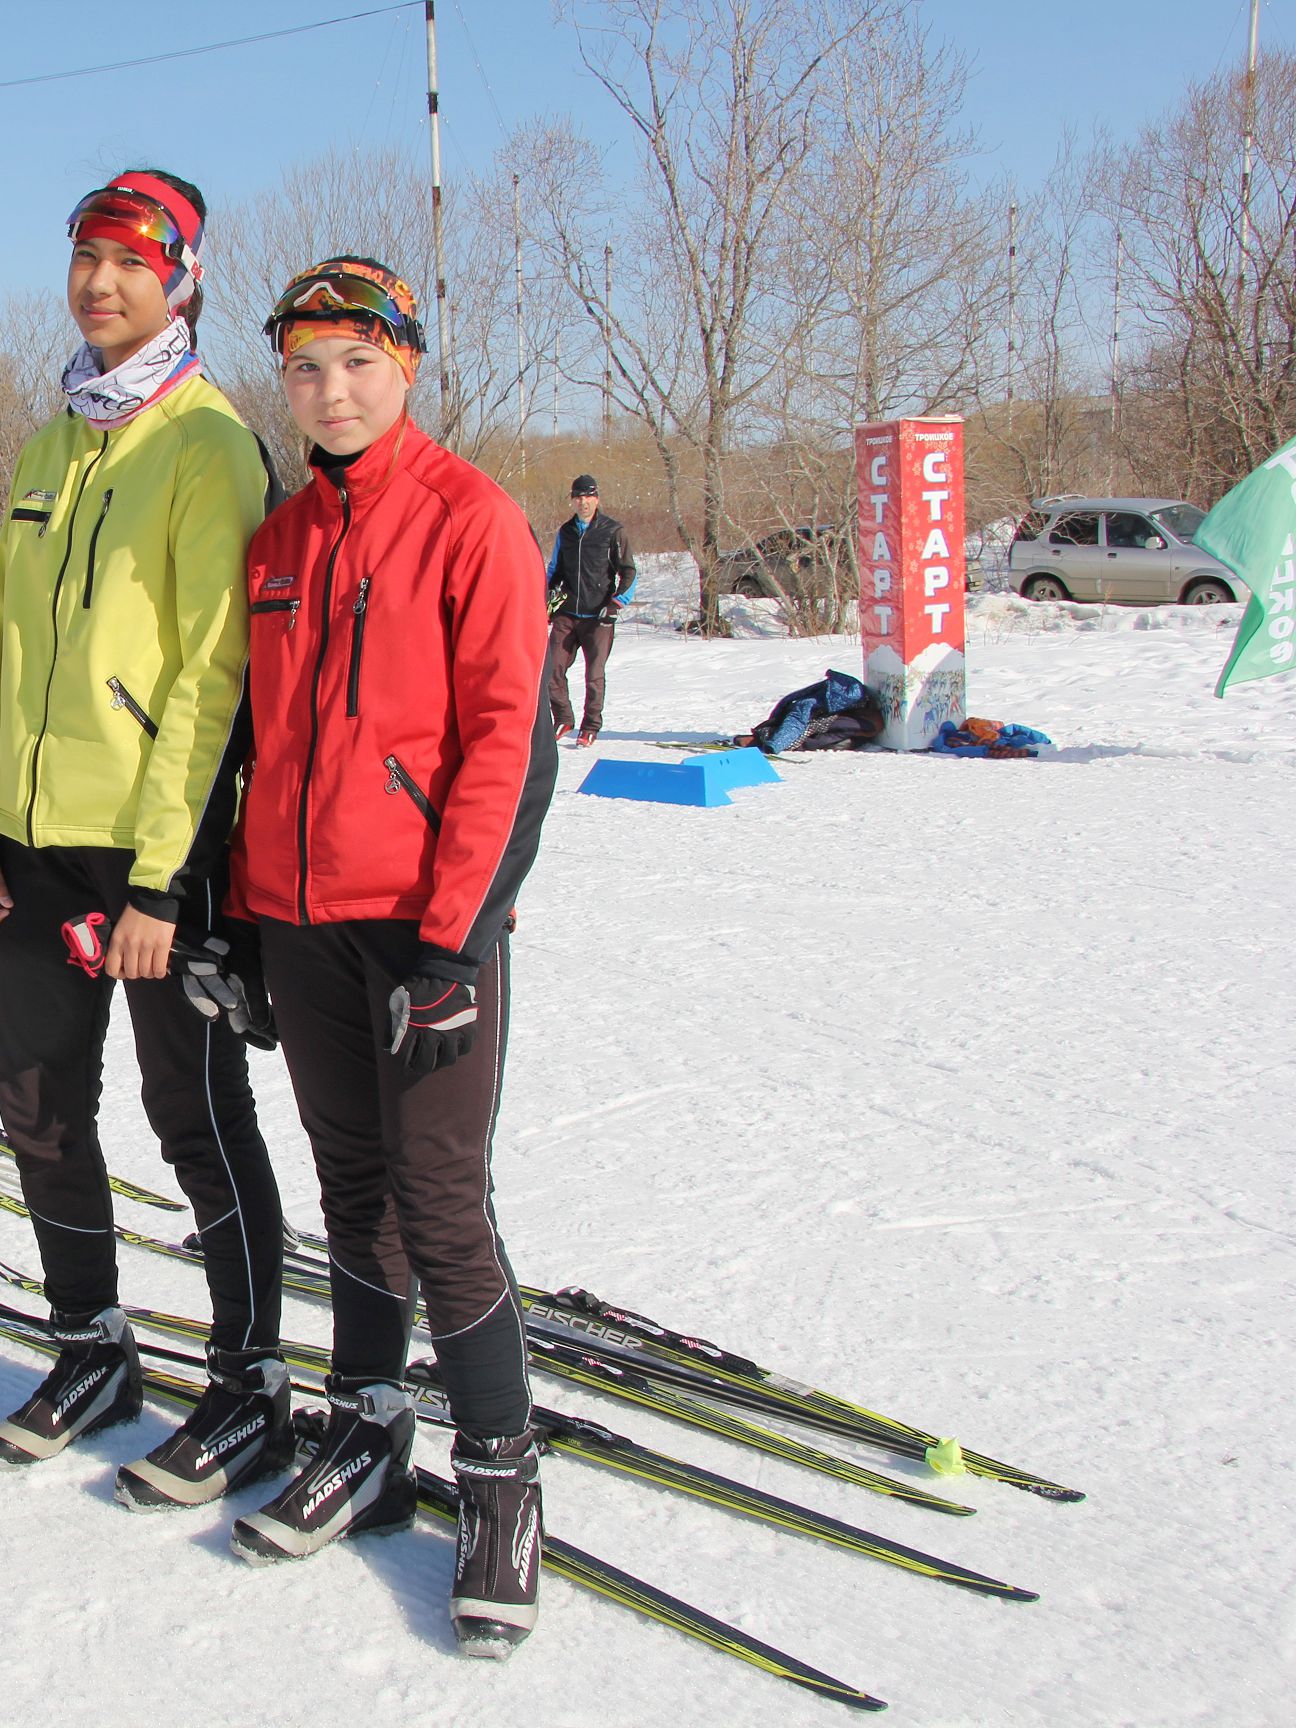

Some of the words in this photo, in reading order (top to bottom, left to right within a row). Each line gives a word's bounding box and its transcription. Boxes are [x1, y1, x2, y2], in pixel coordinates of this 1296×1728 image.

[915, 432, 954, 442] ТРОИЦКОЕ
[869, 455, 894, 636] СТАРТ
[920, 451, 951, 635] СТАРТ
[527, 1302, 644, 1351] FISCHER
[195, 1414, 266, 1471] MADSHUS
[452, 1459, 518, 1477] MADSHUS
[302, 1450, 373, 1520] MADSHUS
